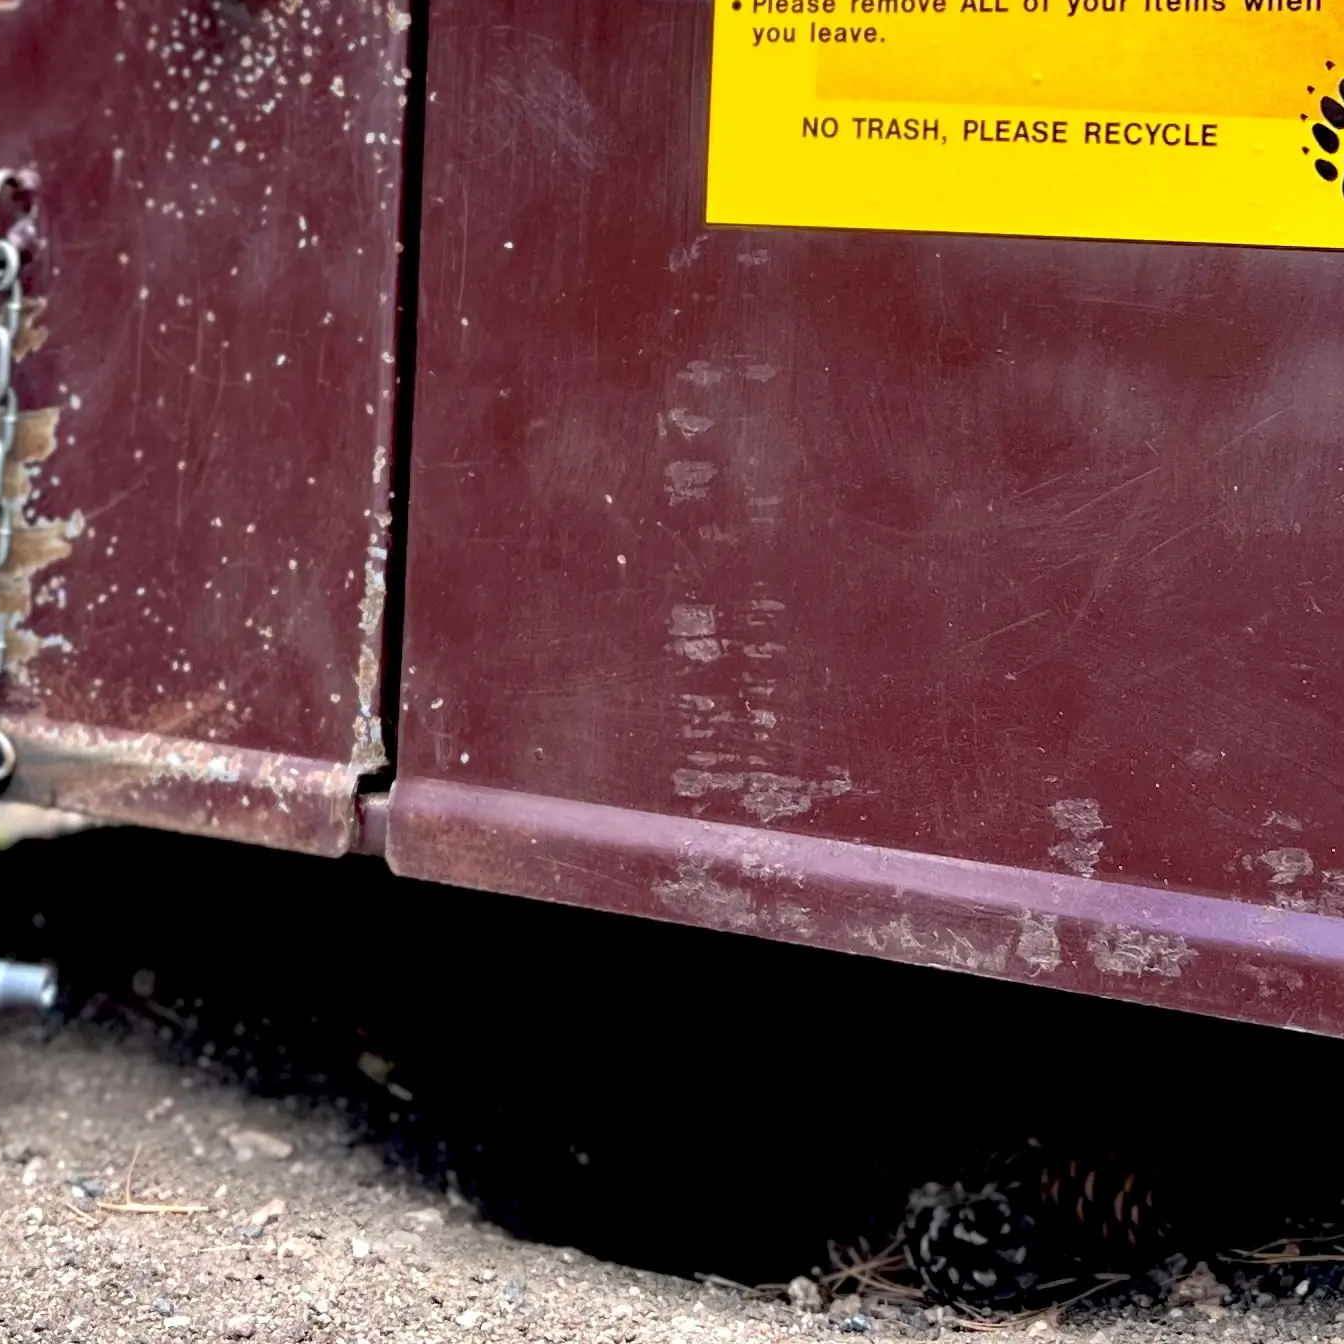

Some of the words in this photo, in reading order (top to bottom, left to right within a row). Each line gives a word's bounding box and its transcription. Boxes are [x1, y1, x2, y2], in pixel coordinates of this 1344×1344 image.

[753, 27, 795, 47] you
[810, 22, 886, 43] leave.
[802, 117, 839, 139] NO
[852, 117, 947, 143] TRASH,
[963, 119, 1068, 144] PLEASE
[1084, 121, 1218, 147] RECYCLE
